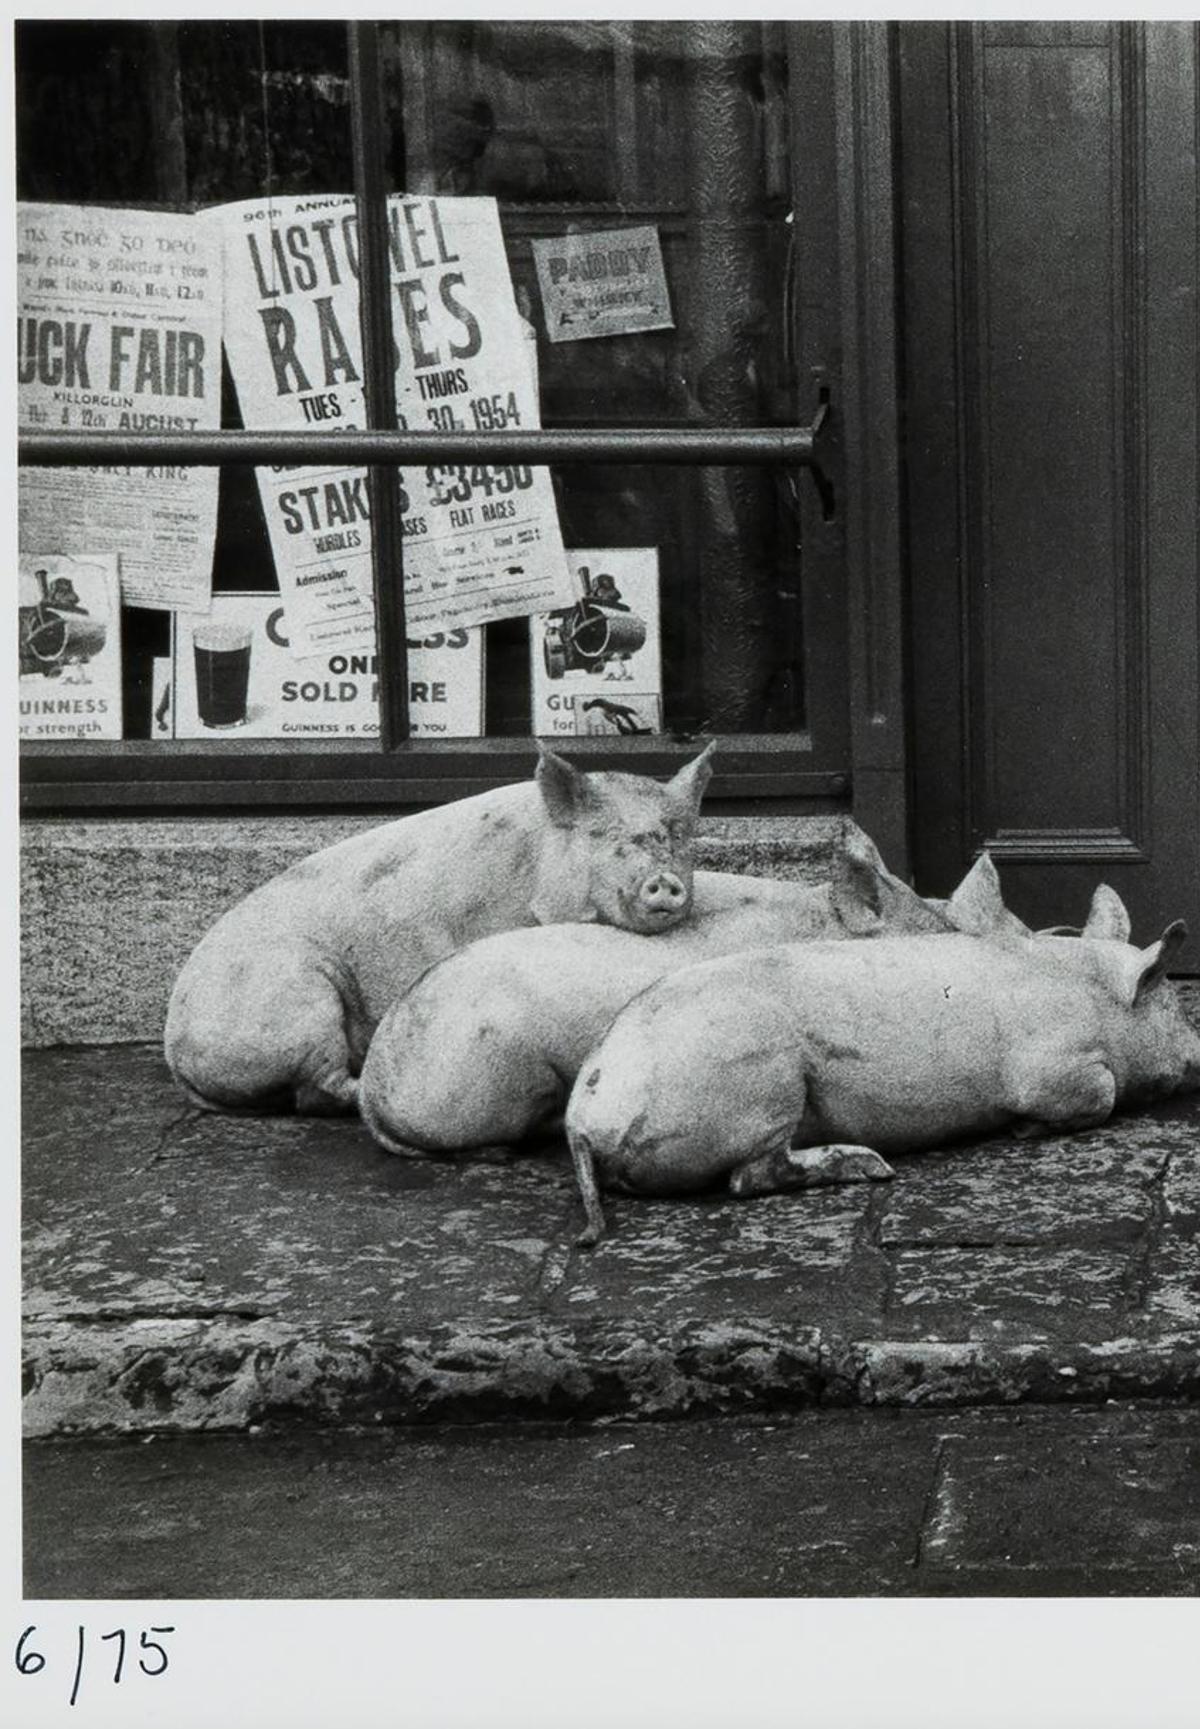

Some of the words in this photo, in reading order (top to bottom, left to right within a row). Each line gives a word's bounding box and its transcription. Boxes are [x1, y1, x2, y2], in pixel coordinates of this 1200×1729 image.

[294, 198, 356, 213] ANNUA
[258, 271, 482, 396] RAES
[17, 317, 91, 389] UCK
[110, 325, 205, 398] FAIR
[54, 392, 133, 407] KILLORGLIN
[300, 393, 342, 422] TUES
[415, 368, 468, 401] THURS
[470, 392, 520, 431] 1954
[450, 507, 474, 528] FLAT
[482, 500, 516, 522] RACES
[281, 681, 358, 703] SOLD
[19, 699, 108, 715] UINNESS
[37, 720, 101, 738] strength
[282, 723, 339, 733] GUINNESS
[422, 724, 447, 733] YOU
[552, 719, 574, 731] for
